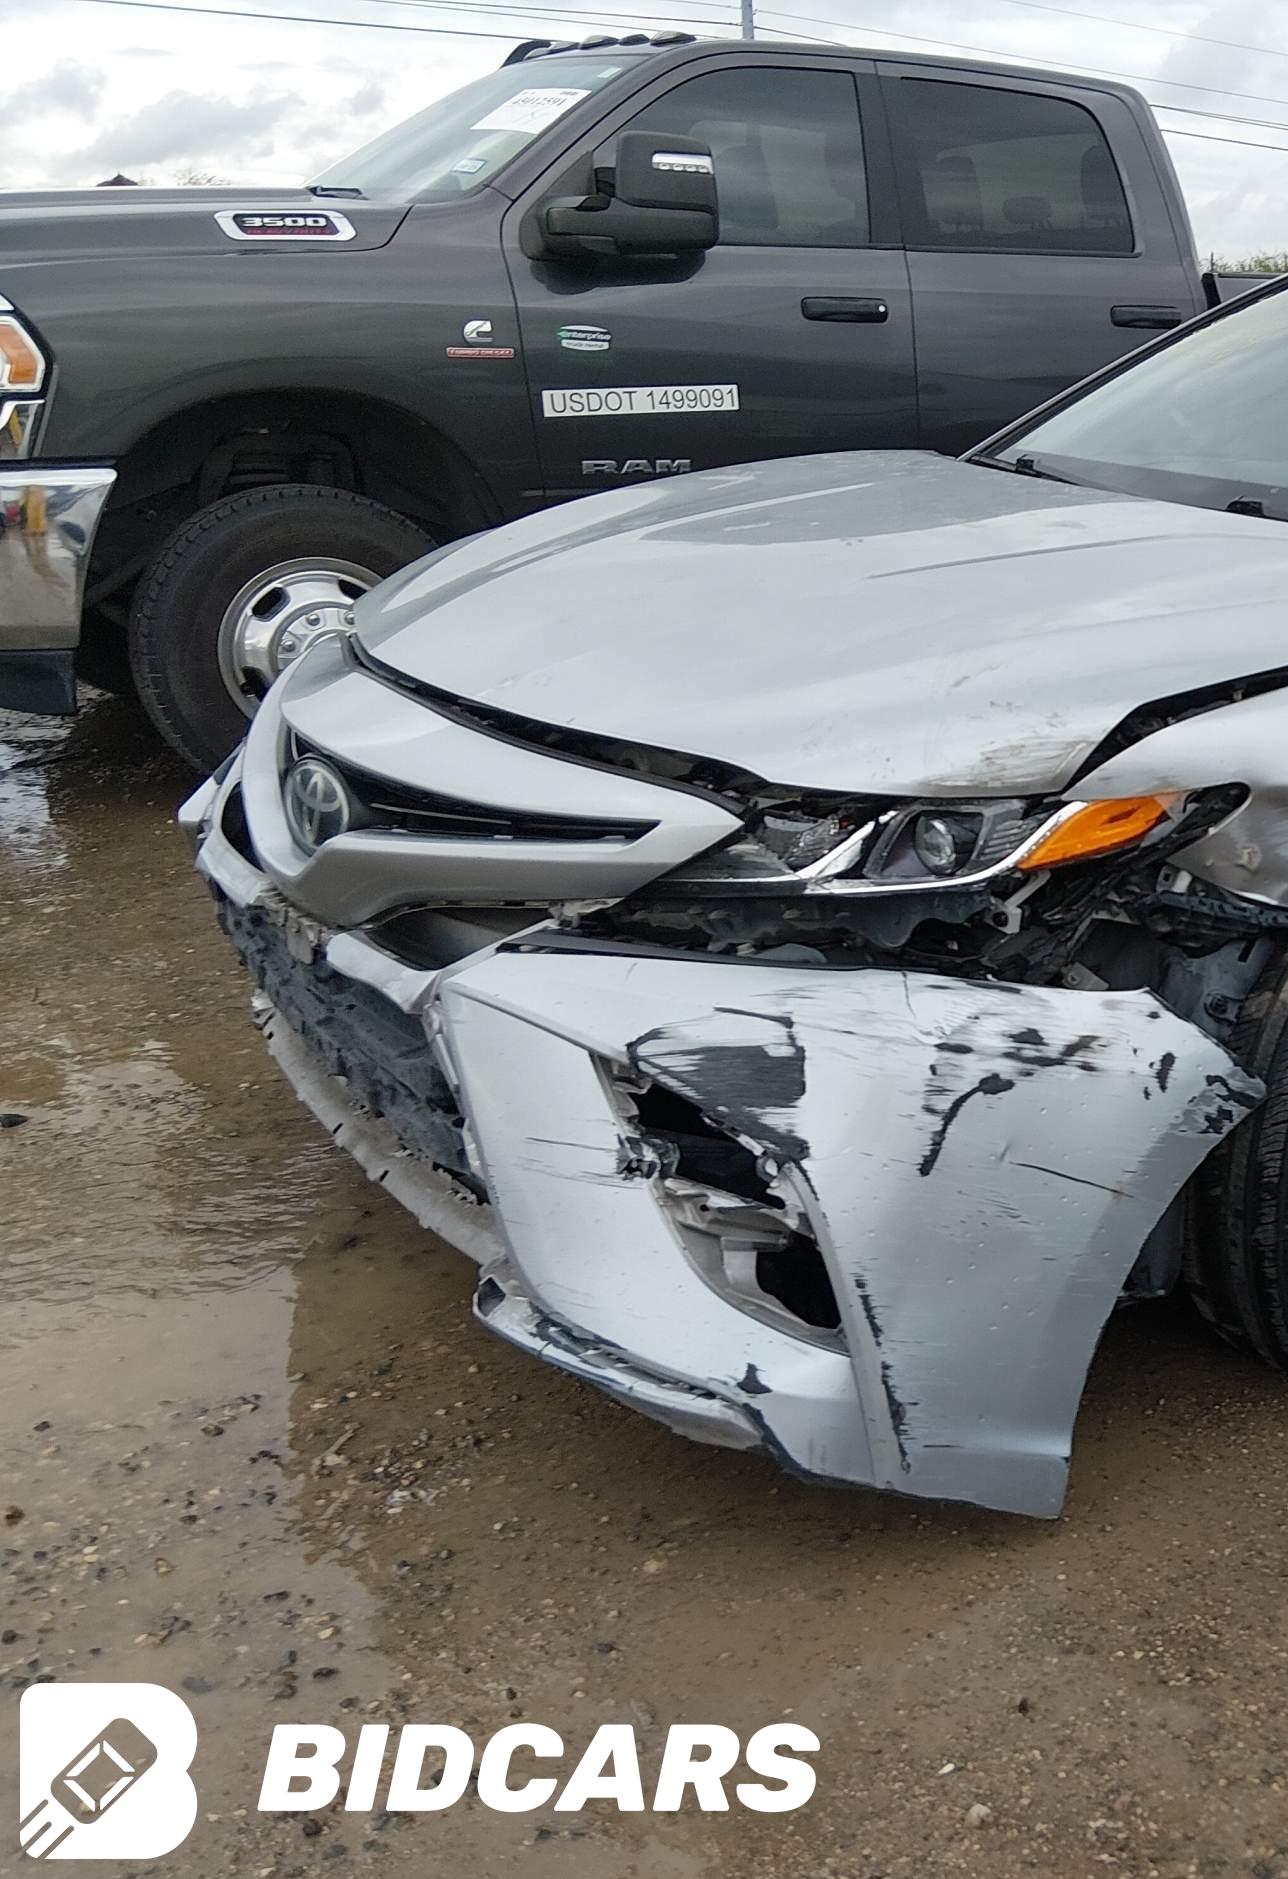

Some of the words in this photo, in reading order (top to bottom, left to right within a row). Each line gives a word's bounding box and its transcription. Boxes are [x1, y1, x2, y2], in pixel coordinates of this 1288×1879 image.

[242, 217, 327, 227] 3500
[550, 391, 637, 414] USDOT
[646, 388, 736, 410] 1499091
[581, 459, 692, 475] RAM
